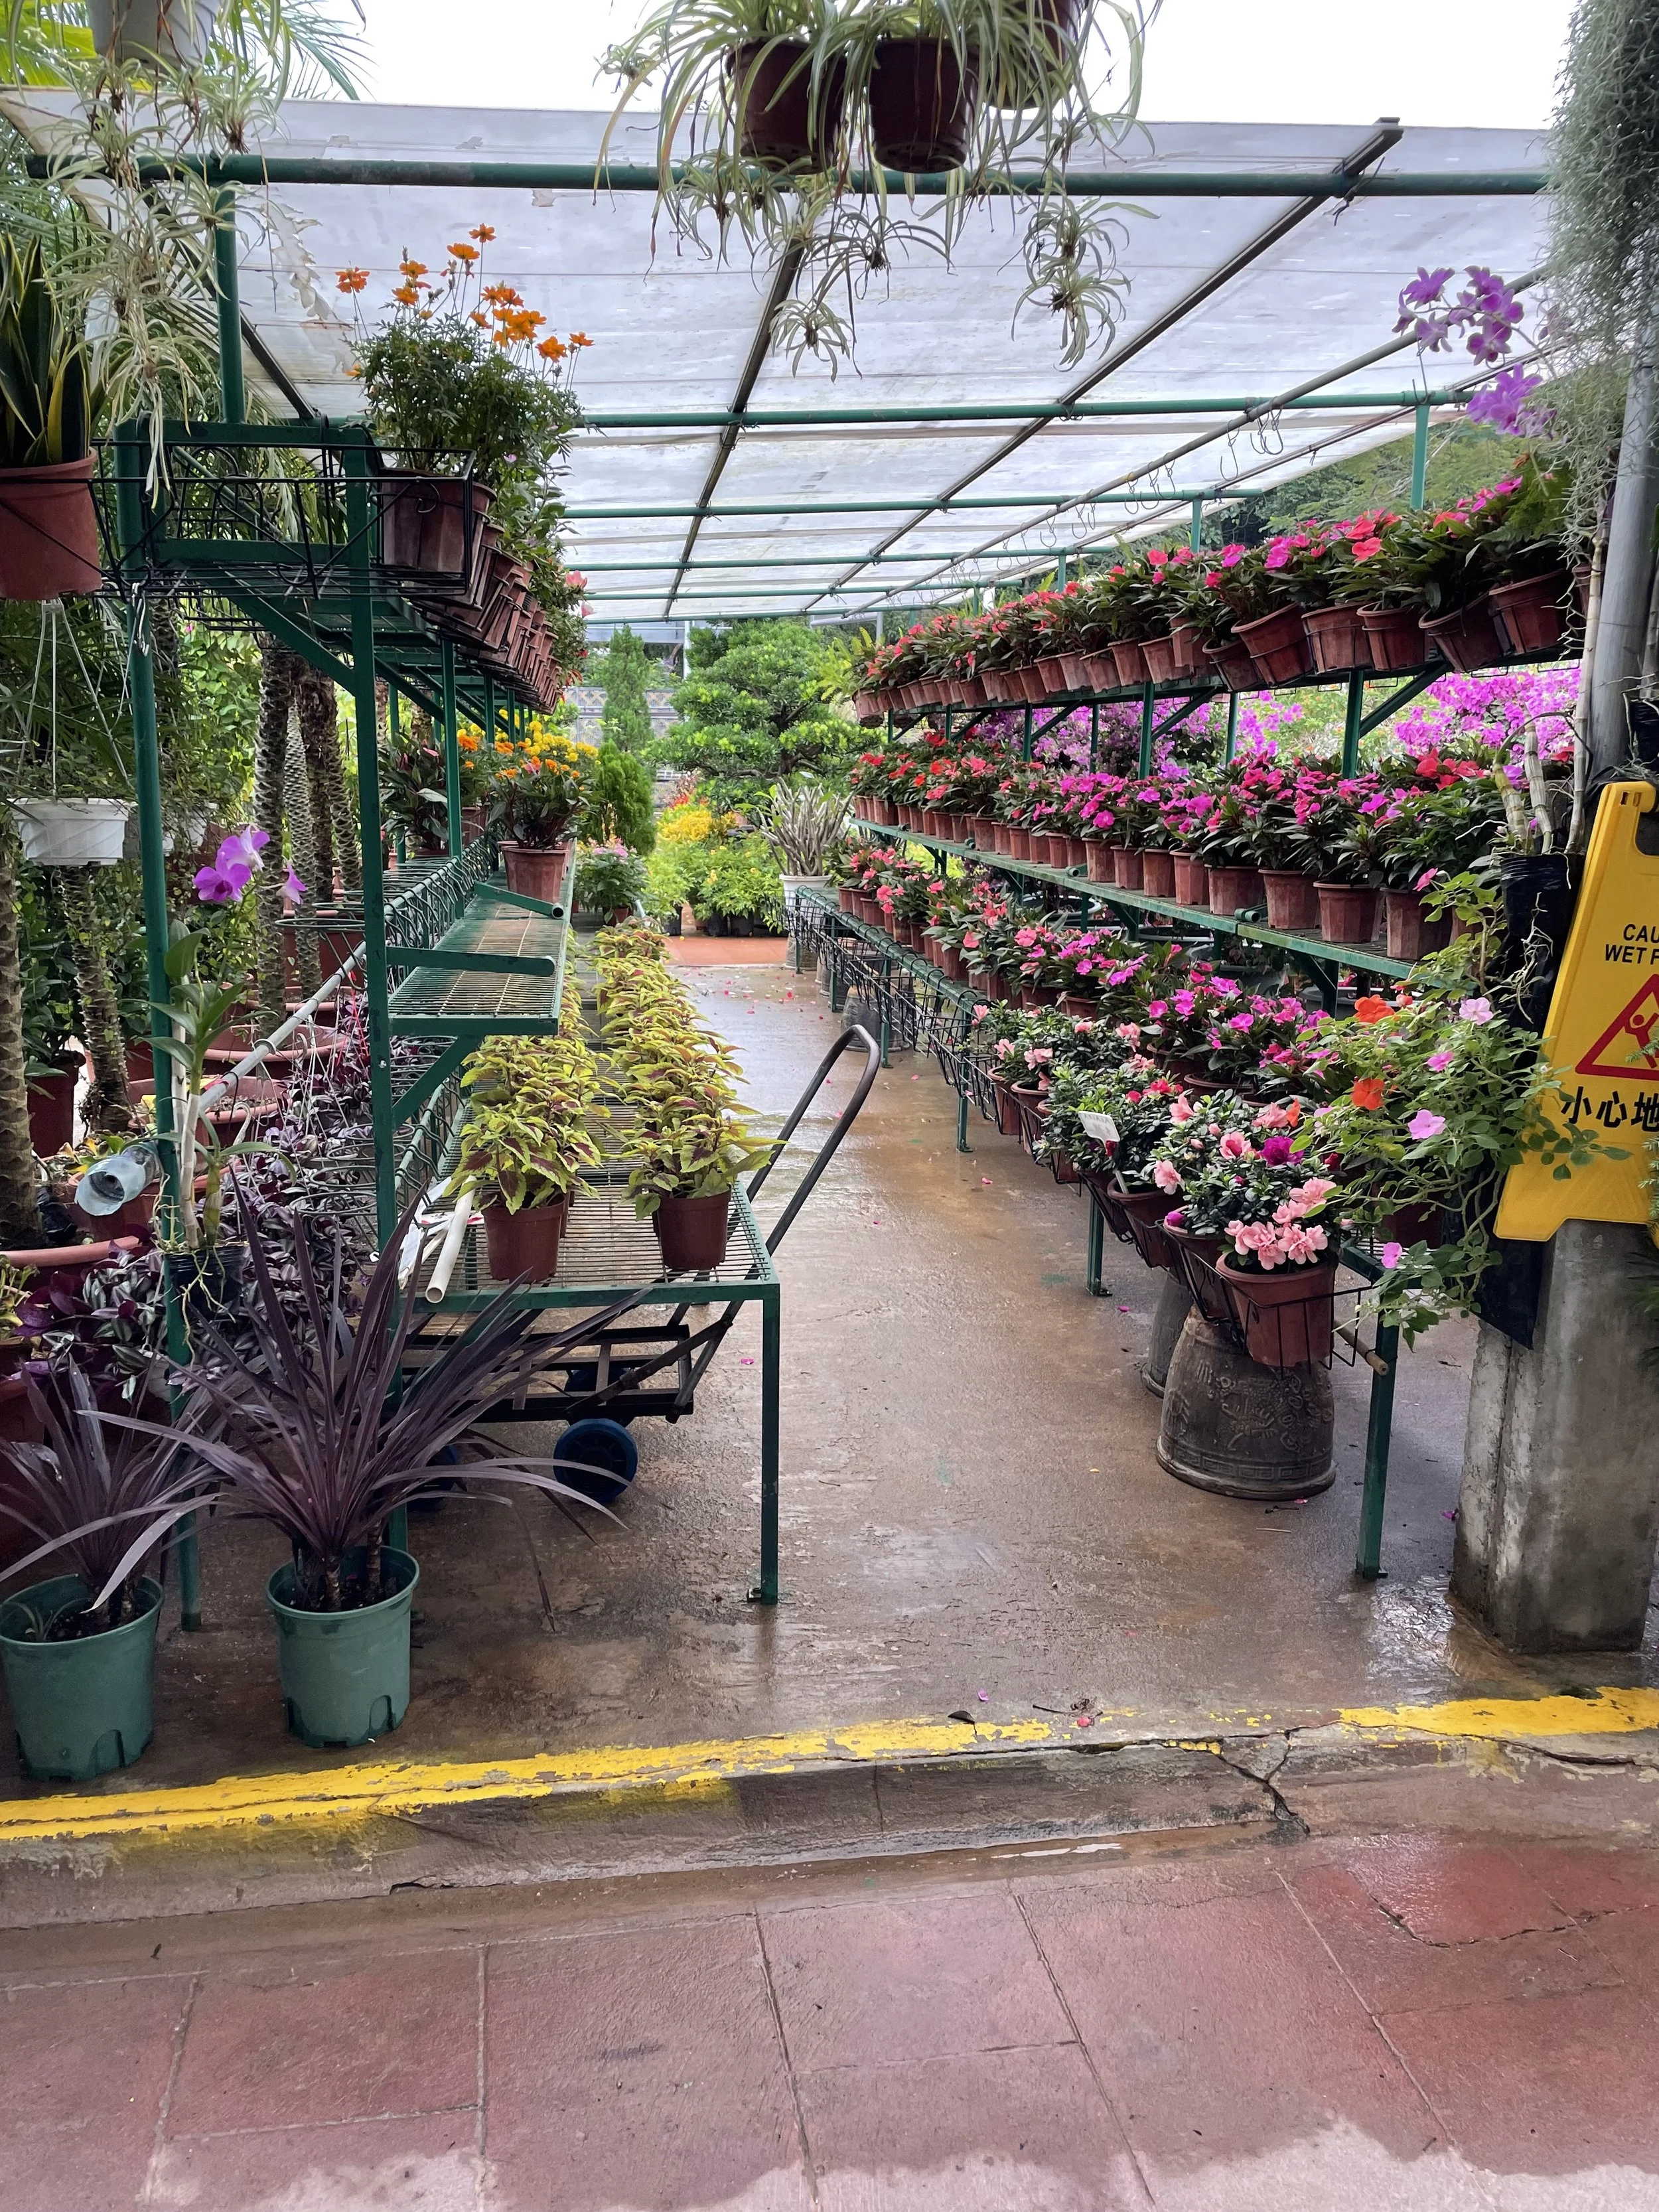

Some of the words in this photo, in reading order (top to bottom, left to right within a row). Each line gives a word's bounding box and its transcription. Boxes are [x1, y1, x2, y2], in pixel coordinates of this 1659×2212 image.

[1605, 944, 1647, 964] WET
[1561, 1086, 1659, 1132] 小心地
